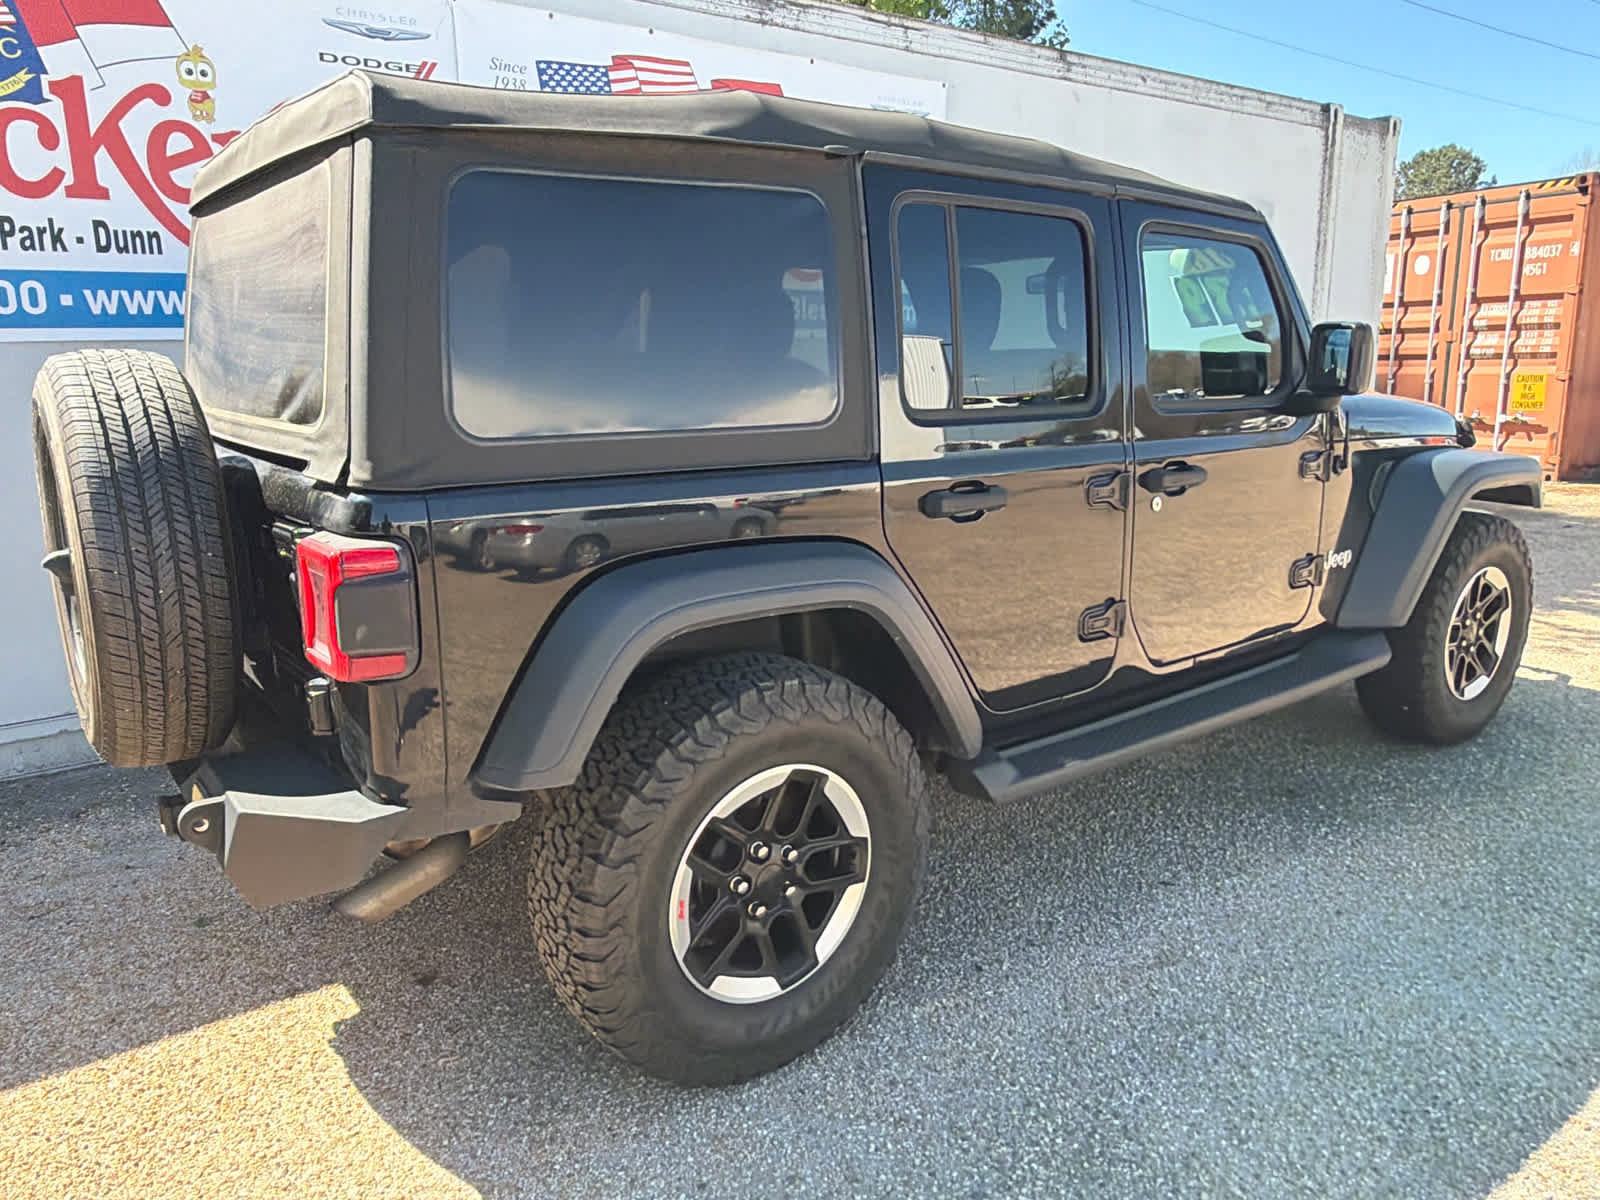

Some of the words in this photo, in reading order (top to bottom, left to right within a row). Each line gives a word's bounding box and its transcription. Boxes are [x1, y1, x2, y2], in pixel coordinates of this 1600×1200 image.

[335, 7, 417, 27] CHRYSLER
[318, 52, 422, 74] DODGE
[489, 56, 528, 75] Since
[494, 75, 528, 90] 1938
[0, 215, 68, 253] Park
[92, 219, 163, 255] Dunn
[1323, 549, 1352, 569] Jeep
